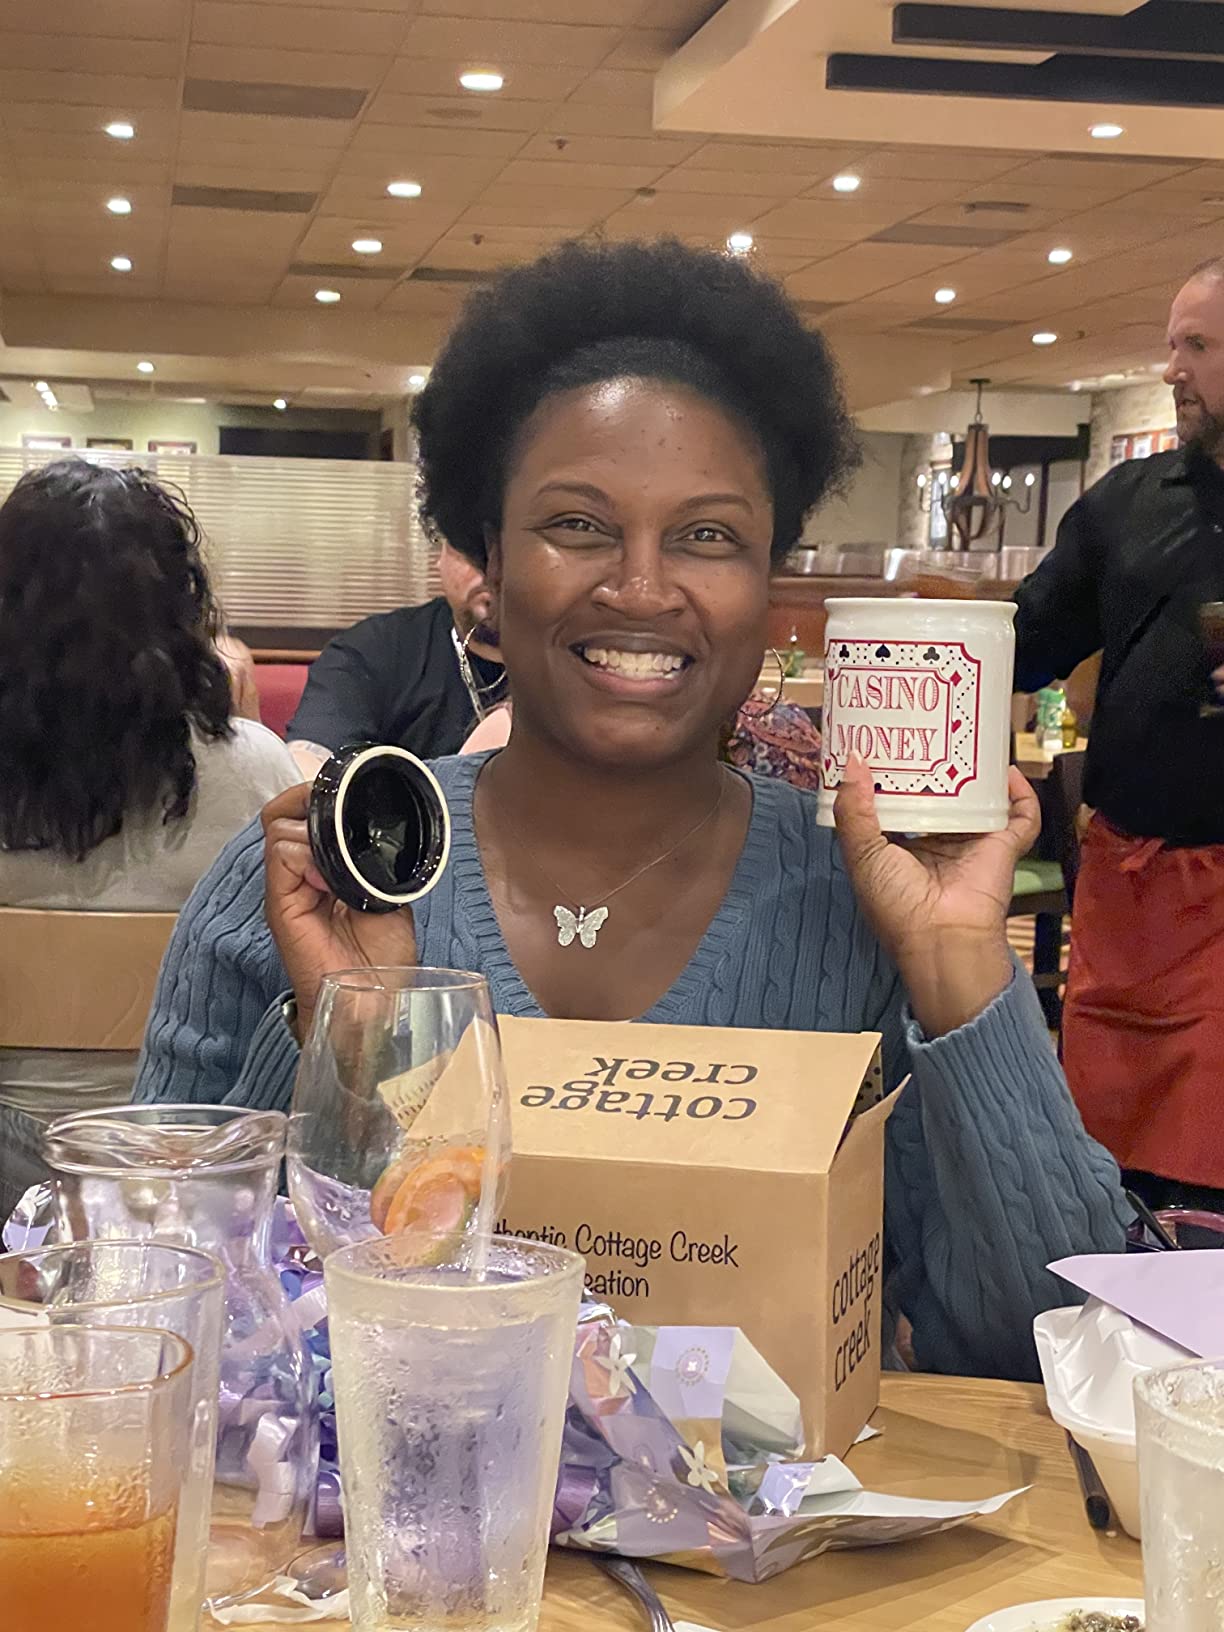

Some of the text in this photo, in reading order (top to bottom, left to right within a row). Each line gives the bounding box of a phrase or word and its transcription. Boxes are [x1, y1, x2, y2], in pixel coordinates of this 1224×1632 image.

[838, 674, 940, 712] CASINO
[837, 724, 938, 762] MONEY
[584, 1056, 759, 1086] creek
[520, 1080, 758, 1122] cottage
[575, 1223, 662, 1268] Cottage
[670, 1231, 739, 1268] Creek
[583, 1269, 650, 1298] eation
[832, 1231, 880, 1325] cottage
[834, 1299, 871, 1392] creek
